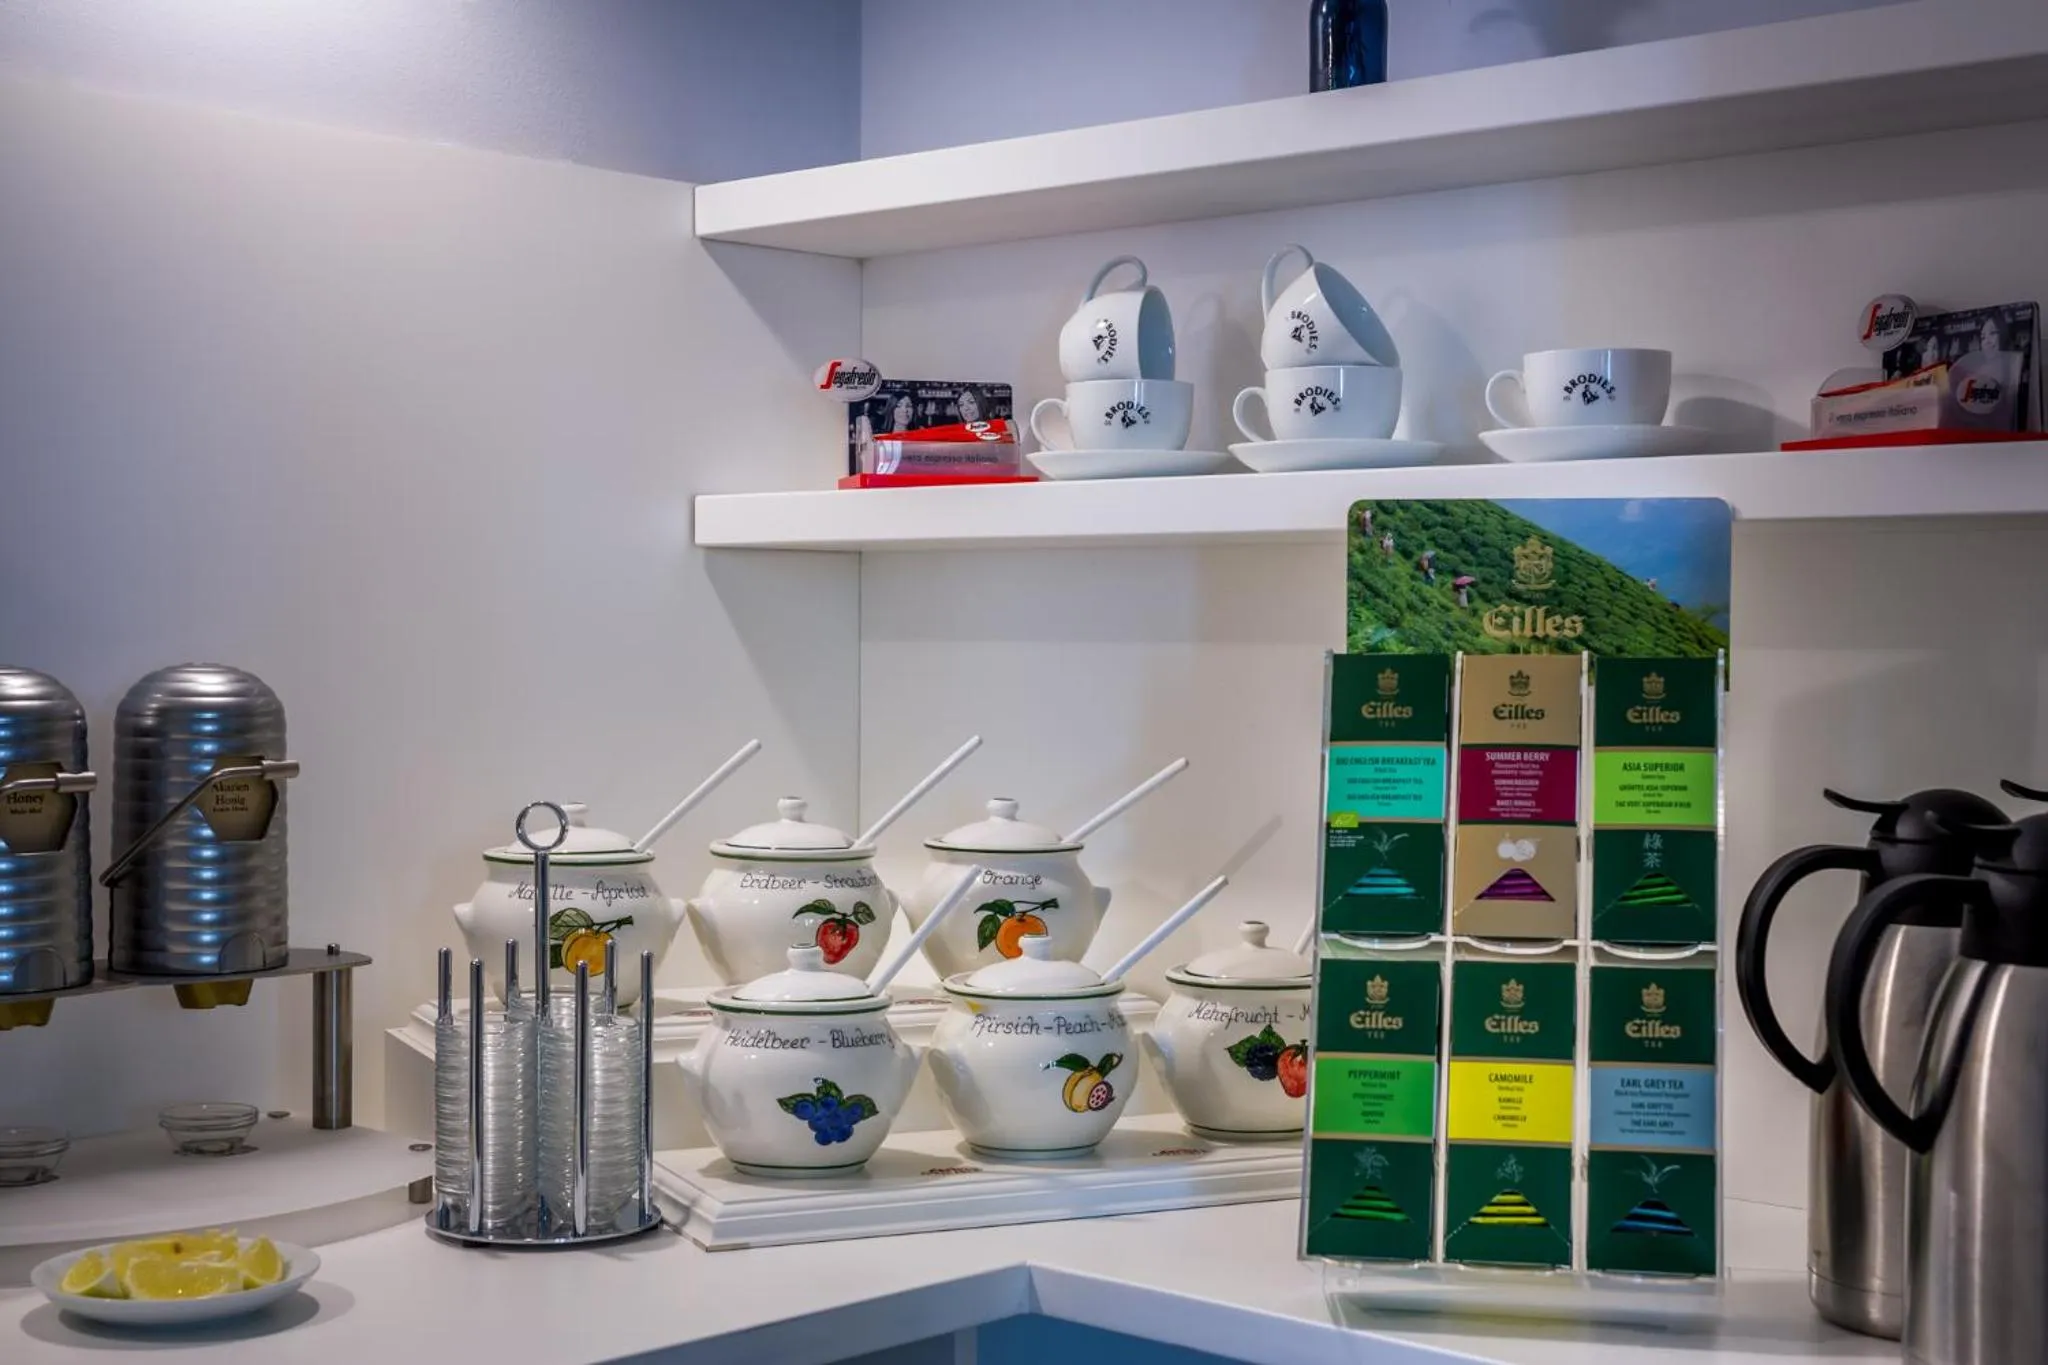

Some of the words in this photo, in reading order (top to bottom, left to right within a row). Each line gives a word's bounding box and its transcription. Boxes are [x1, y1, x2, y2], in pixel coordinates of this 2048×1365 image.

[1290, 310, 1319, 350] BRODIES
[819, 361, 876, 389] Segafredo
[1564, 373, 1616, 395] BRODIES
[1293, 386, 1341, 407] BRODIES
[1104, 400, 1151, 420] BRODIES
[1483, 604, 1585, 638] Eilles
[1360, 701, 1413, 719] Eilles
[1493, 703, 1545, 720] Eilles
[1626, 705, 1681, 723] Eilles
[1485, 751, 1522, 761] SUMMER
[1523, 752, 1550, 762] BERRY
[1622, 762, 1642, 772] ASIA
[1643, 762, 1685, 773] SUPERIOR
[7, 792, 45, 806] Honey
[740, 872, 807, 890] Erdbeer
[982, 869, 1043, 890] Orange
[1349, 1010, 1404, 1029] Eilles
[1484, 1014, 1540, 1033] Eilles
[1624, 1019, 1682, 1038] Eilles
[1347, 1069, 1402, 1080] PEPPERMINT
[1488, 1074, 1534, 1084] CAMOMILE
[1620, 1078, 1642, 1088] EARL
[1644, 1078, 1666, 1090] GREY
[1667, 1080, 1685, 1090] TEA
